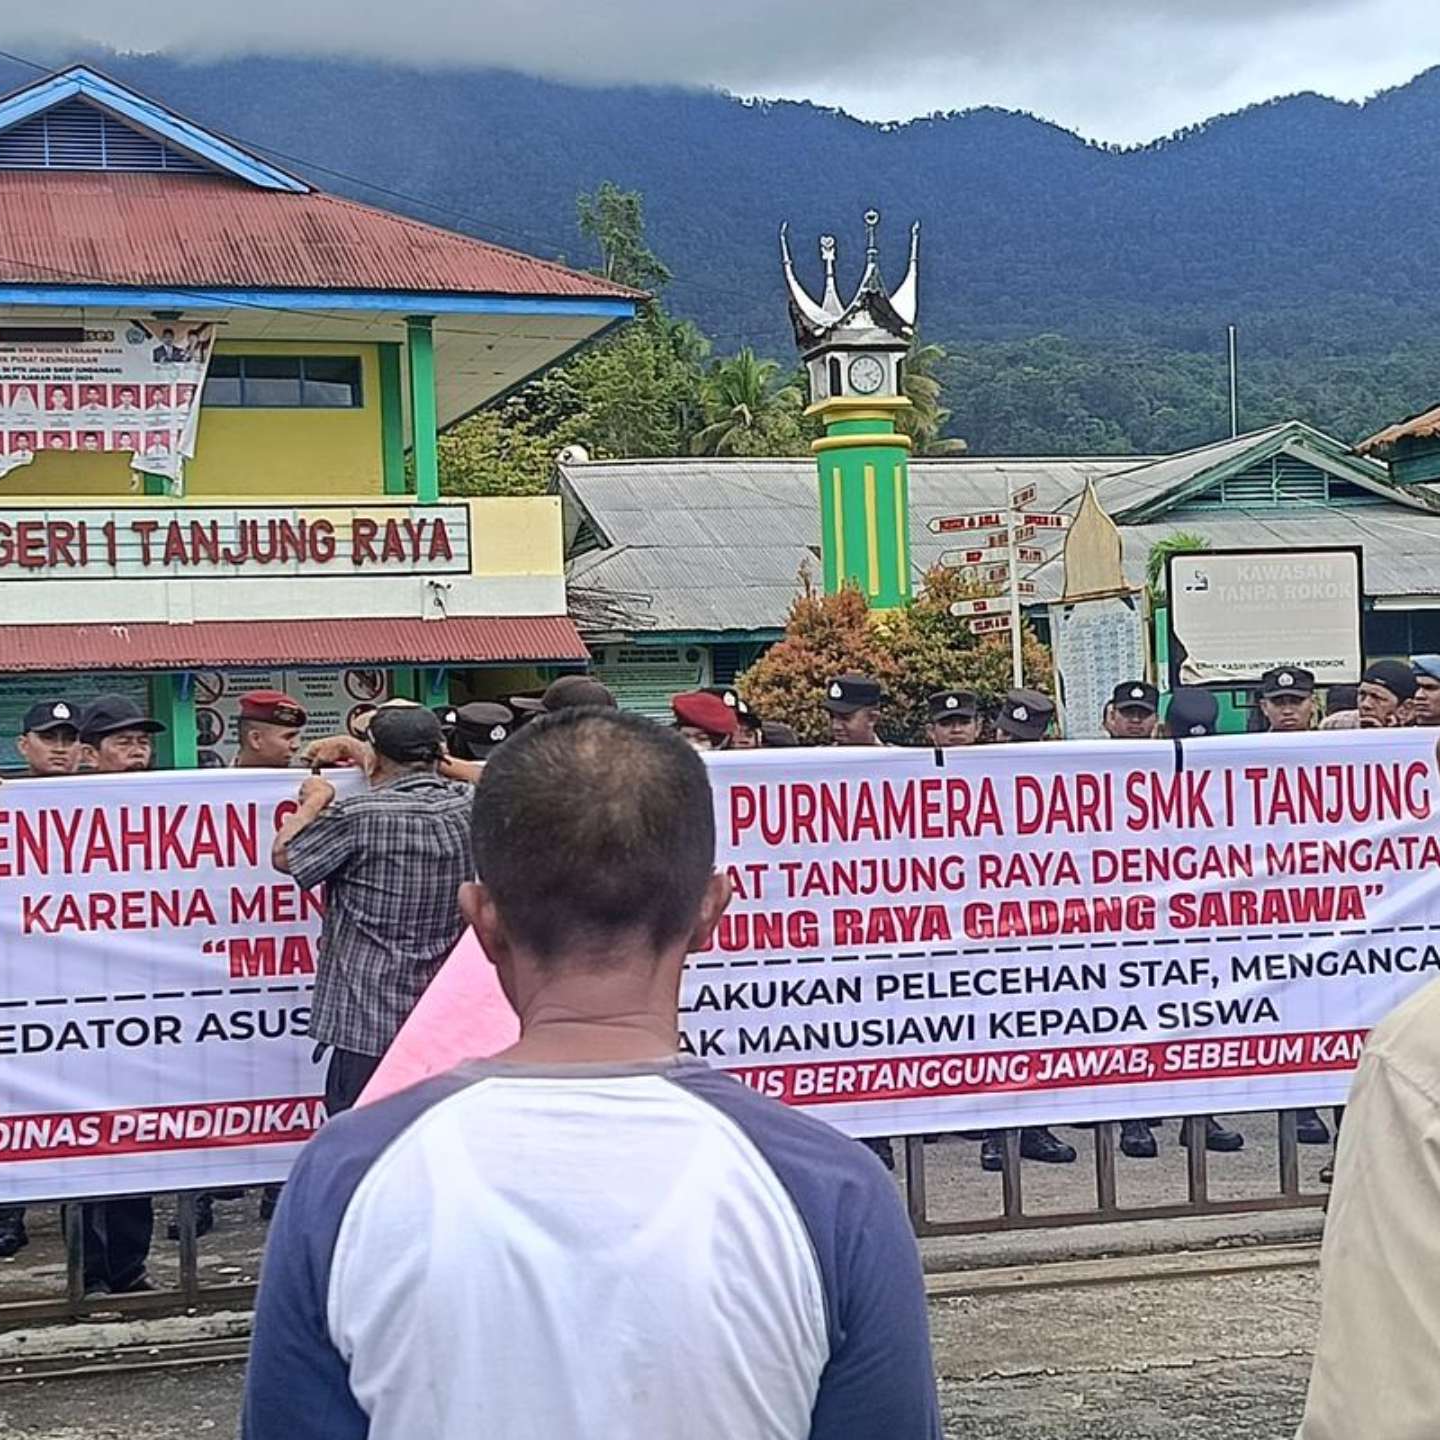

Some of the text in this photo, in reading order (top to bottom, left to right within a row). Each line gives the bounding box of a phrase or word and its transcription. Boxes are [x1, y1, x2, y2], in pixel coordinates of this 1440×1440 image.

[131, 518, 337, 565] TANJUNG
[351, 517, 453, 565] RAYA
[1217, 582, 1353, 601] TANPA ROKOK
[1237, 561, 1333, 581] KAWASAN
[729, 776, 1005, 847] PURNAMERA
[1014, 772, 1112, 837] DARI
[1125, 768, 1214, 832] SMK
[1245, 761, 1430, 825] TANJUNG
[22, 888, 217, 935] KARENA
[780, 855, 966, 899] TANJUNG
[978, 850, 1080, 890] RAYA
[1092, 843, 1253, 884] DENGAN
[202, 935, 327, 979] “MA
[698, 908, 819, 953] UNG
[832, 904, 952, 946] RAYA
[963, 896, 1157, 941] GADANG
[876, 963, 1106, 1002] PELECEHAN
[1118, 958, 1219, 990] STAF,
[738, 1014, 976, 1056] MANUSIAWI
[988, 1004, 1147, 1040] KEPADA
[1157, 997, 1280, 1030] SISWA
[728, 1068, 785, 1098] US
[792, 1054, 1030, 1097] BERTANGGUNG
[1036, 1047, 1155, 1082] JAWAB,
[1163, 1038, 1304, 1073] SEBELUM
